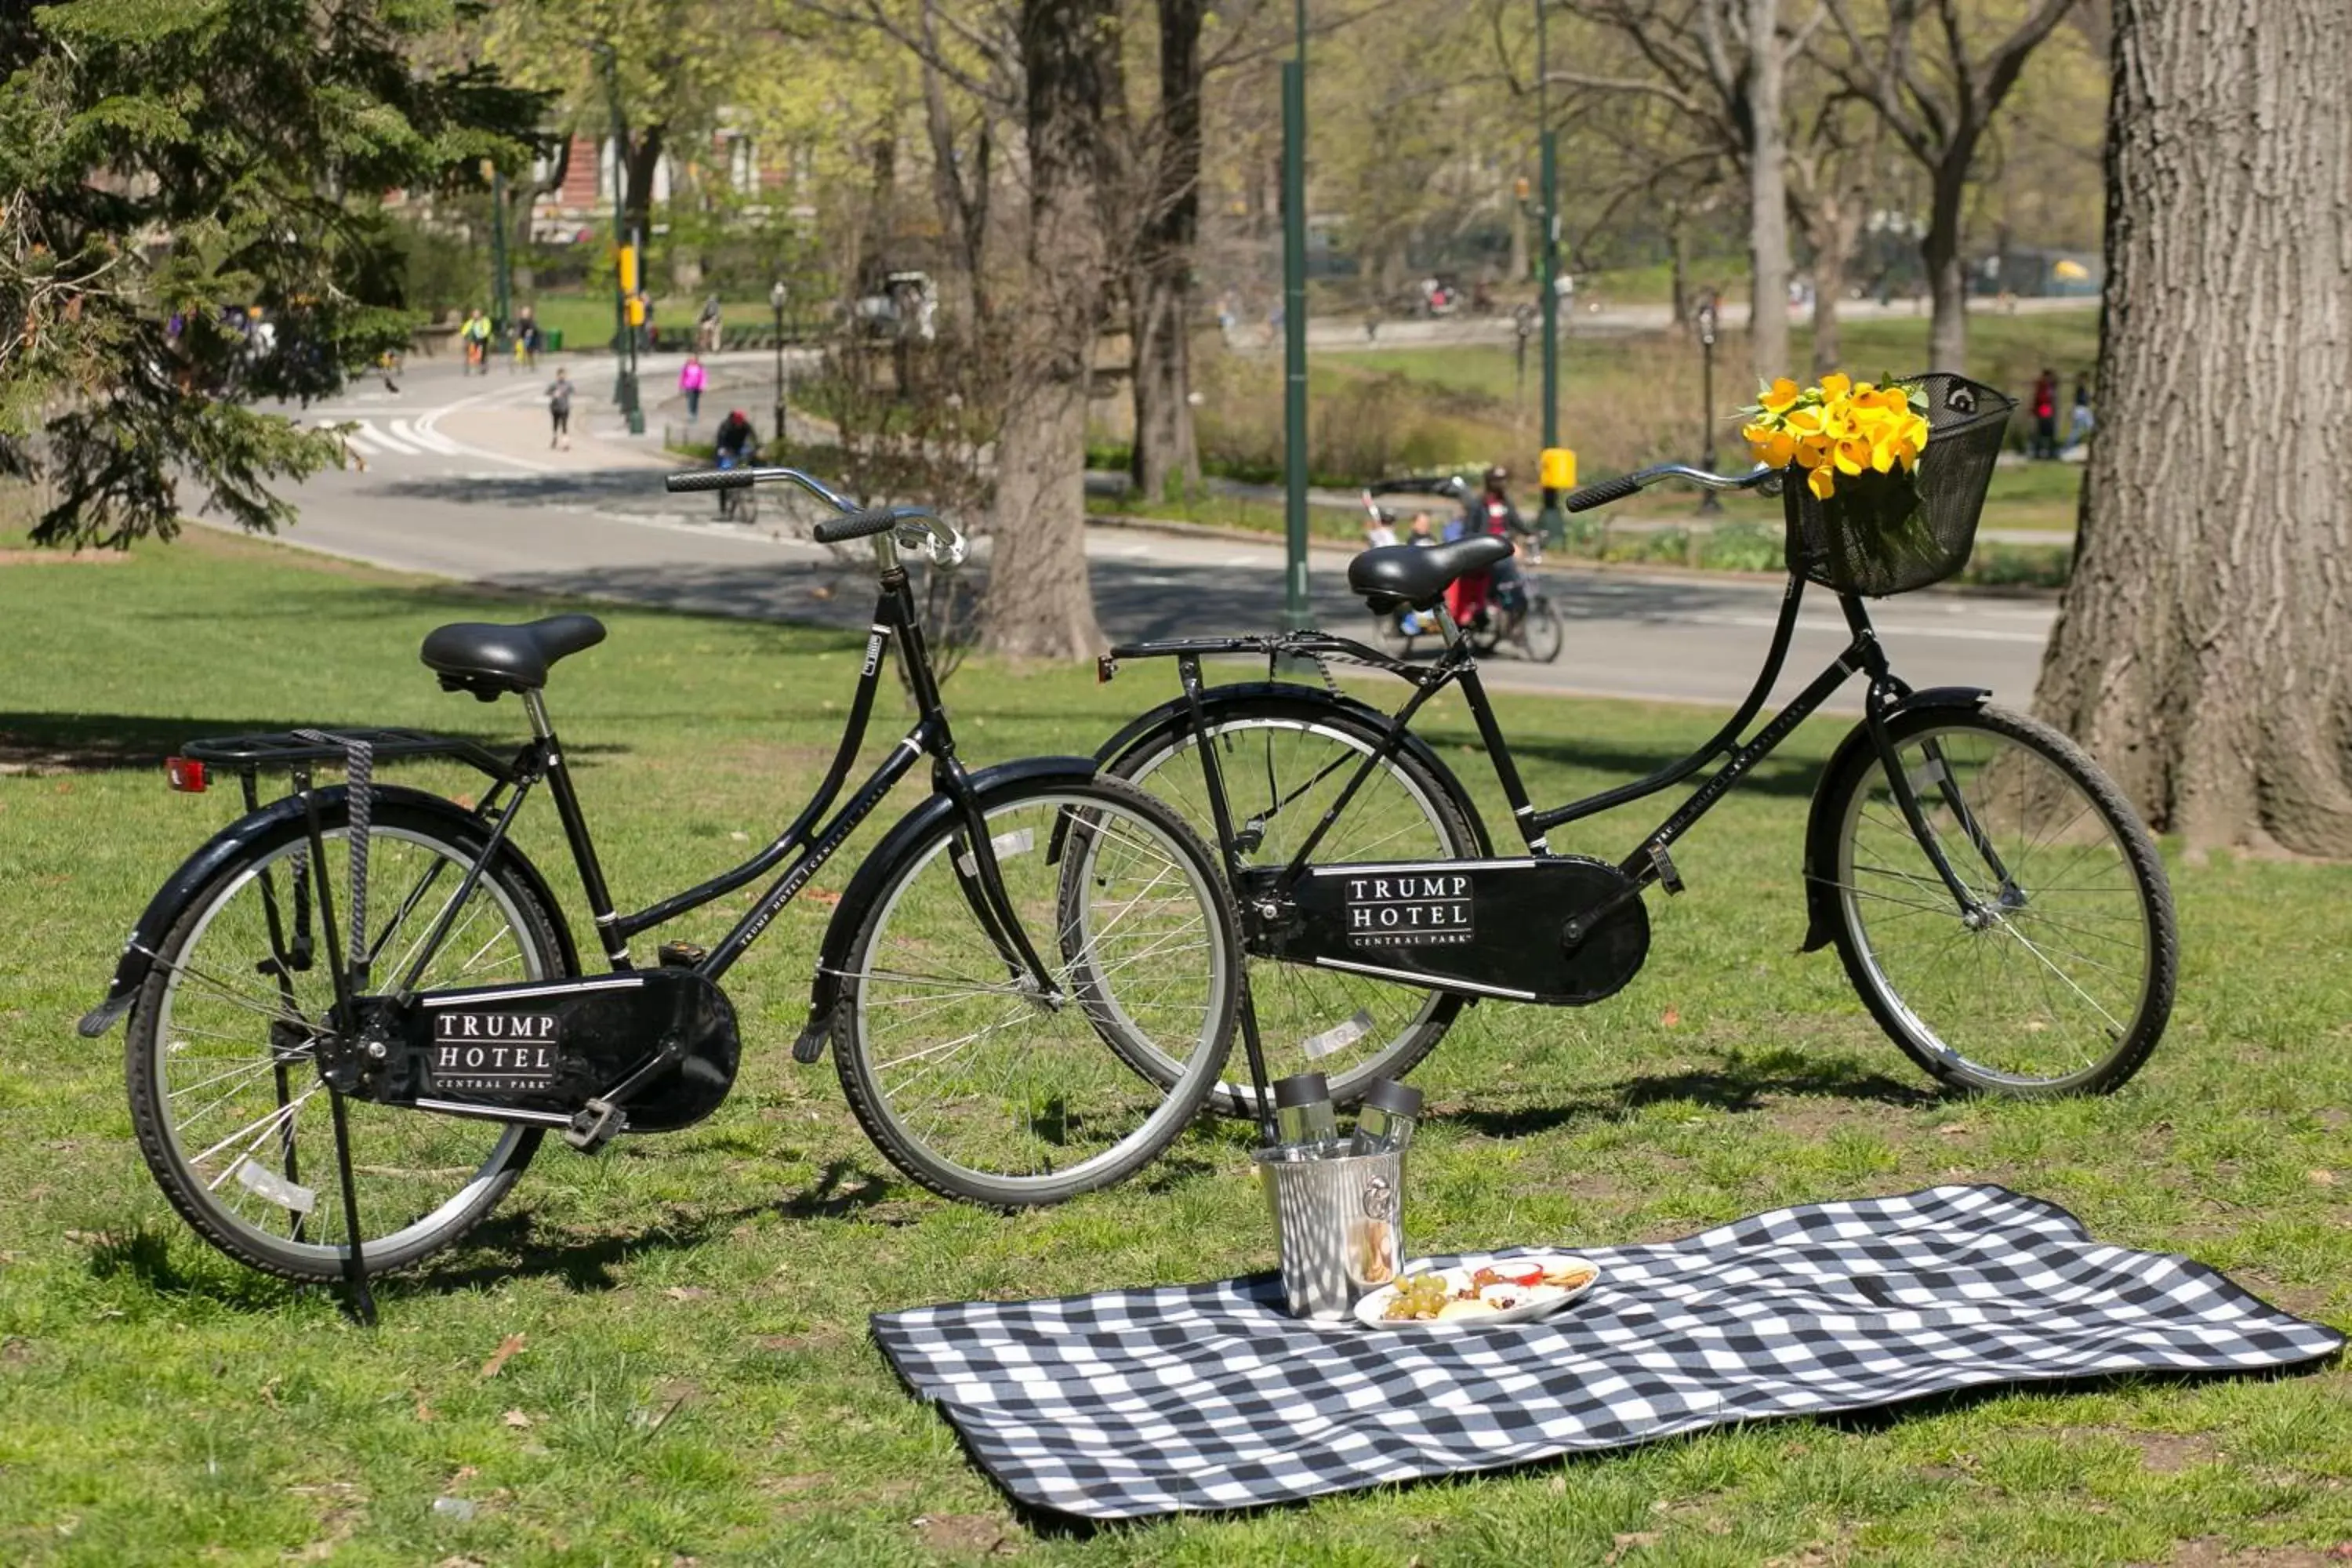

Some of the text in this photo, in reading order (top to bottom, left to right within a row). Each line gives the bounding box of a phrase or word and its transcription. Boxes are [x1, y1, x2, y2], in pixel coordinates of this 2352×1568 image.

[1351, 877, 1467, 899] TRUMP
[740, 913, 769, 946] TRUMP
[772, 878, 801, 910] HOTEL
[1352, 906, 1468, 927] HOTEL
[1354, 936, 1421, 947] CENTRAL
[439, 1015, 554, 1037] TRUMP
[438, 1047, 550, 1068] HOTEL
[436, 1079, 502, 1089] CENTRAL
